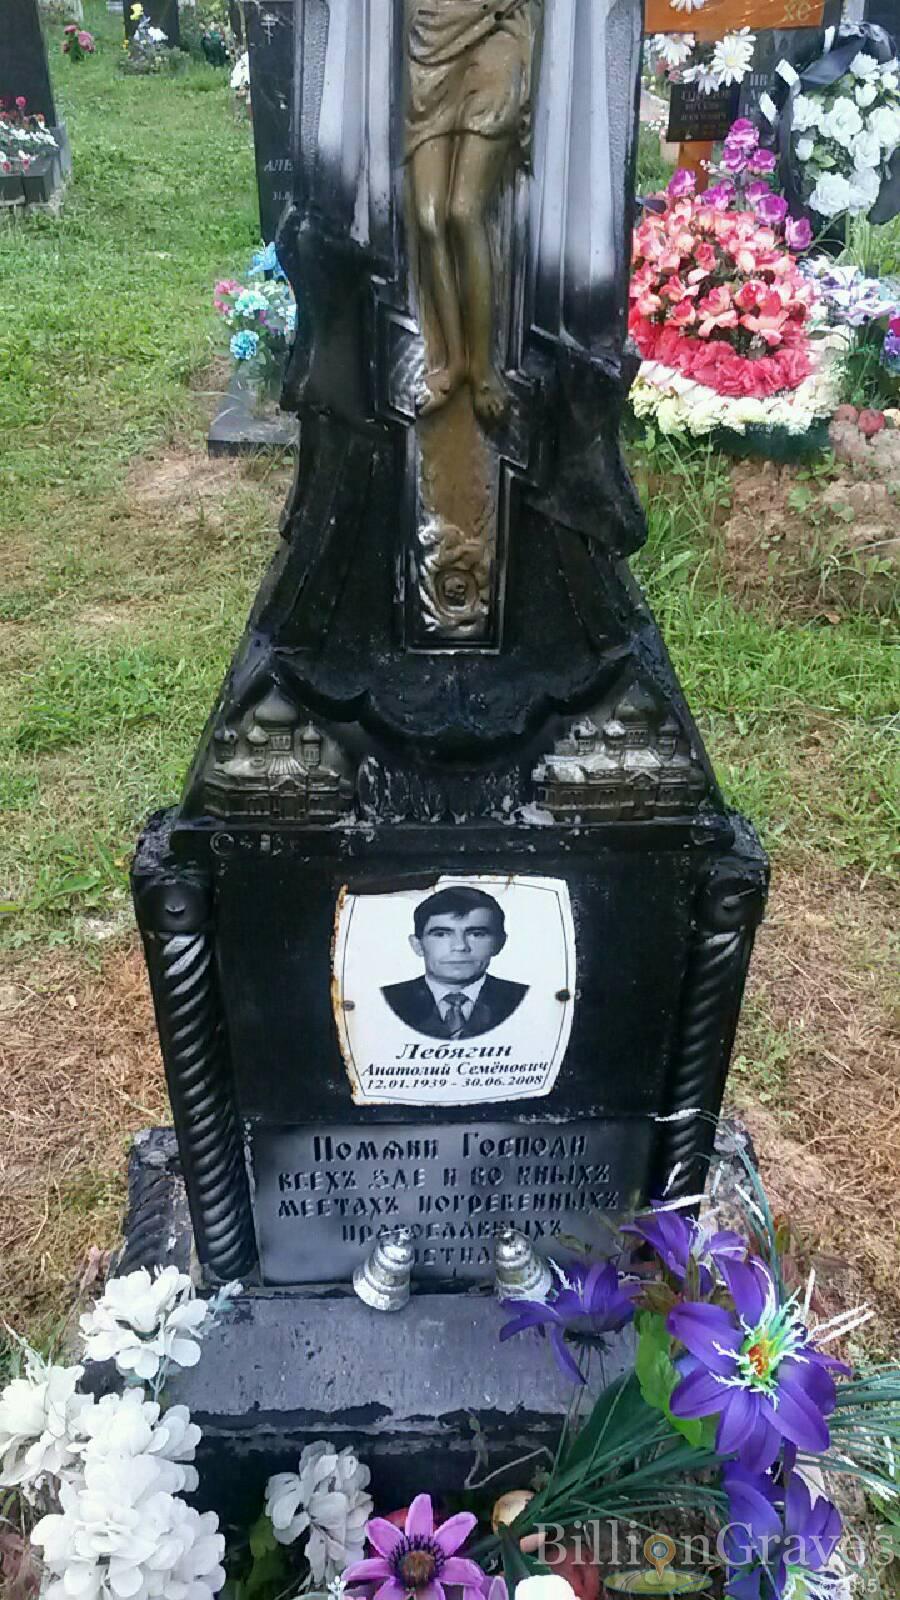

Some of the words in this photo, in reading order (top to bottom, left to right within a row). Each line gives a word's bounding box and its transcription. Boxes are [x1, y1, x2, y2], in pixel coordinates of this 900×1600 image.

[396, 1043, 512, 1060] Лебягин
[361, 1063, 451, 1076] Анатолий
[457, 1061, 550, 1075] Семёнович
[367, 1079, 447, 1090] 12.01.1939
[461, 1075, 545, 1088] 30.06.2008
